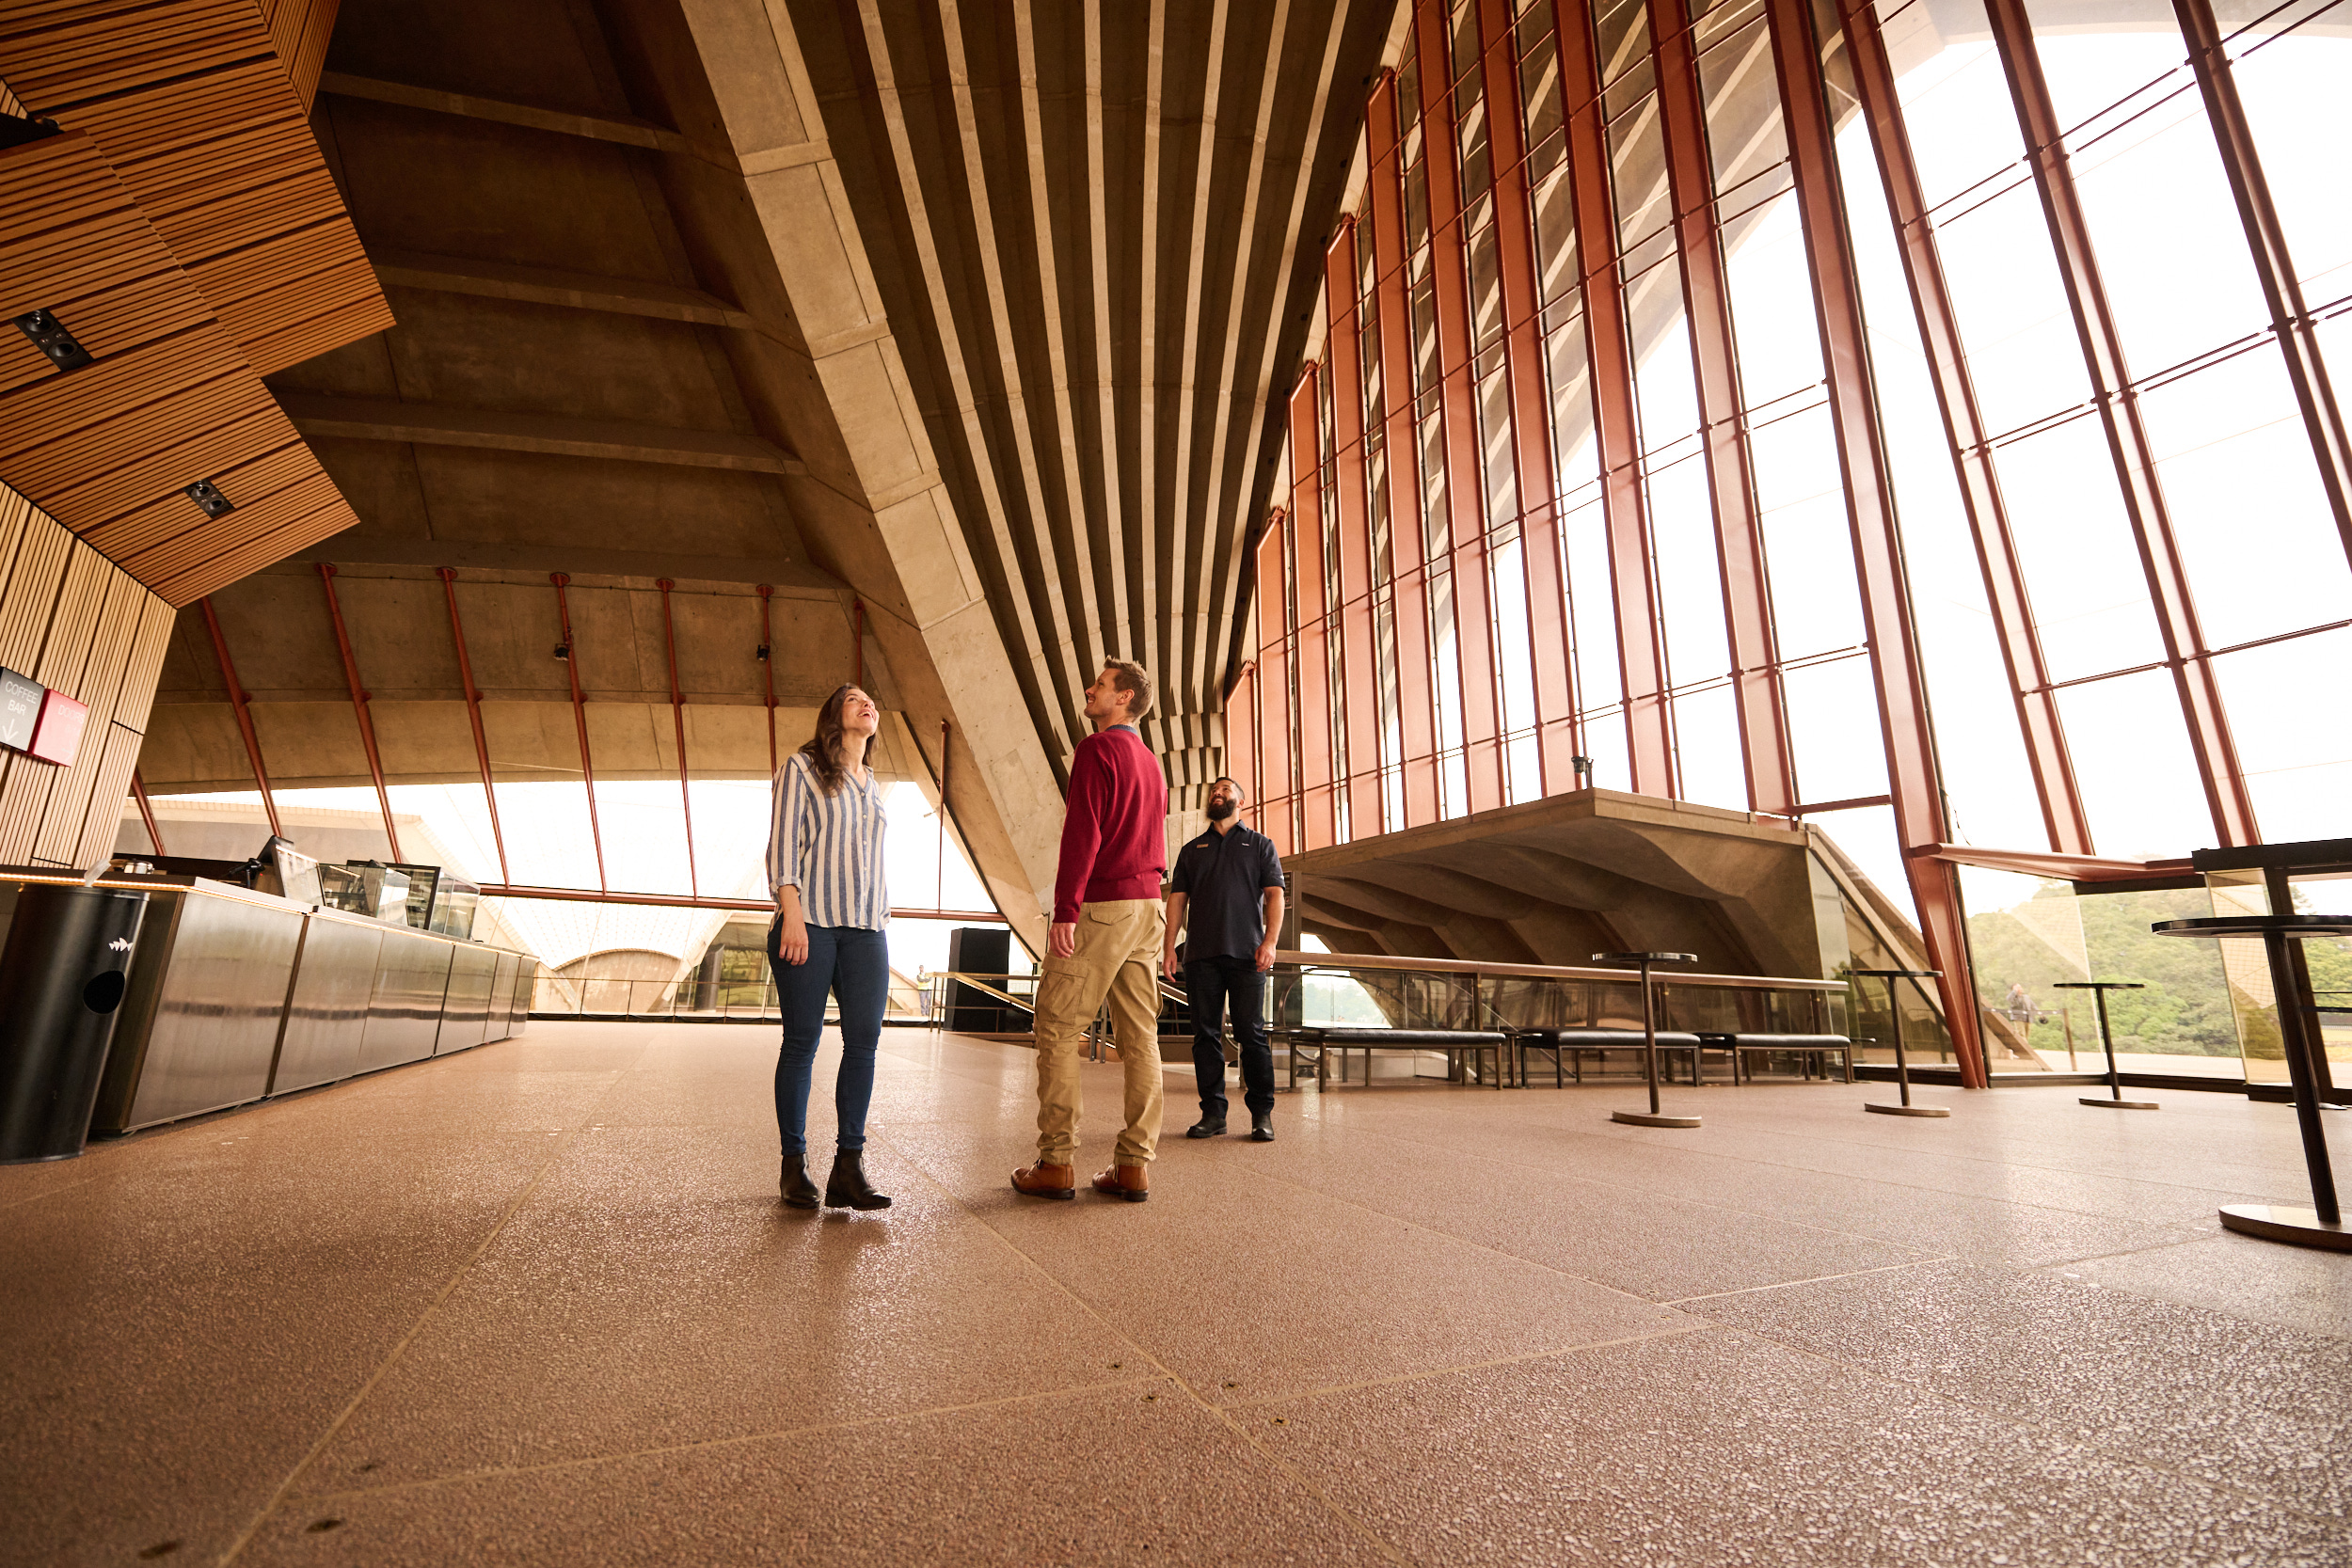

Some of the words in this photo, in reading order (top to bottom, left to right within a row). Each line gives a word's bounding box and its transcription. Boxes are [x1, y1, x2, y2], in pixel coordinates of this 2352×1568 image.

[6, 681, 39, 705] COFFEE
[8, 699, 26, 716] BAR
[58, 705, 86, 724] DOORS
